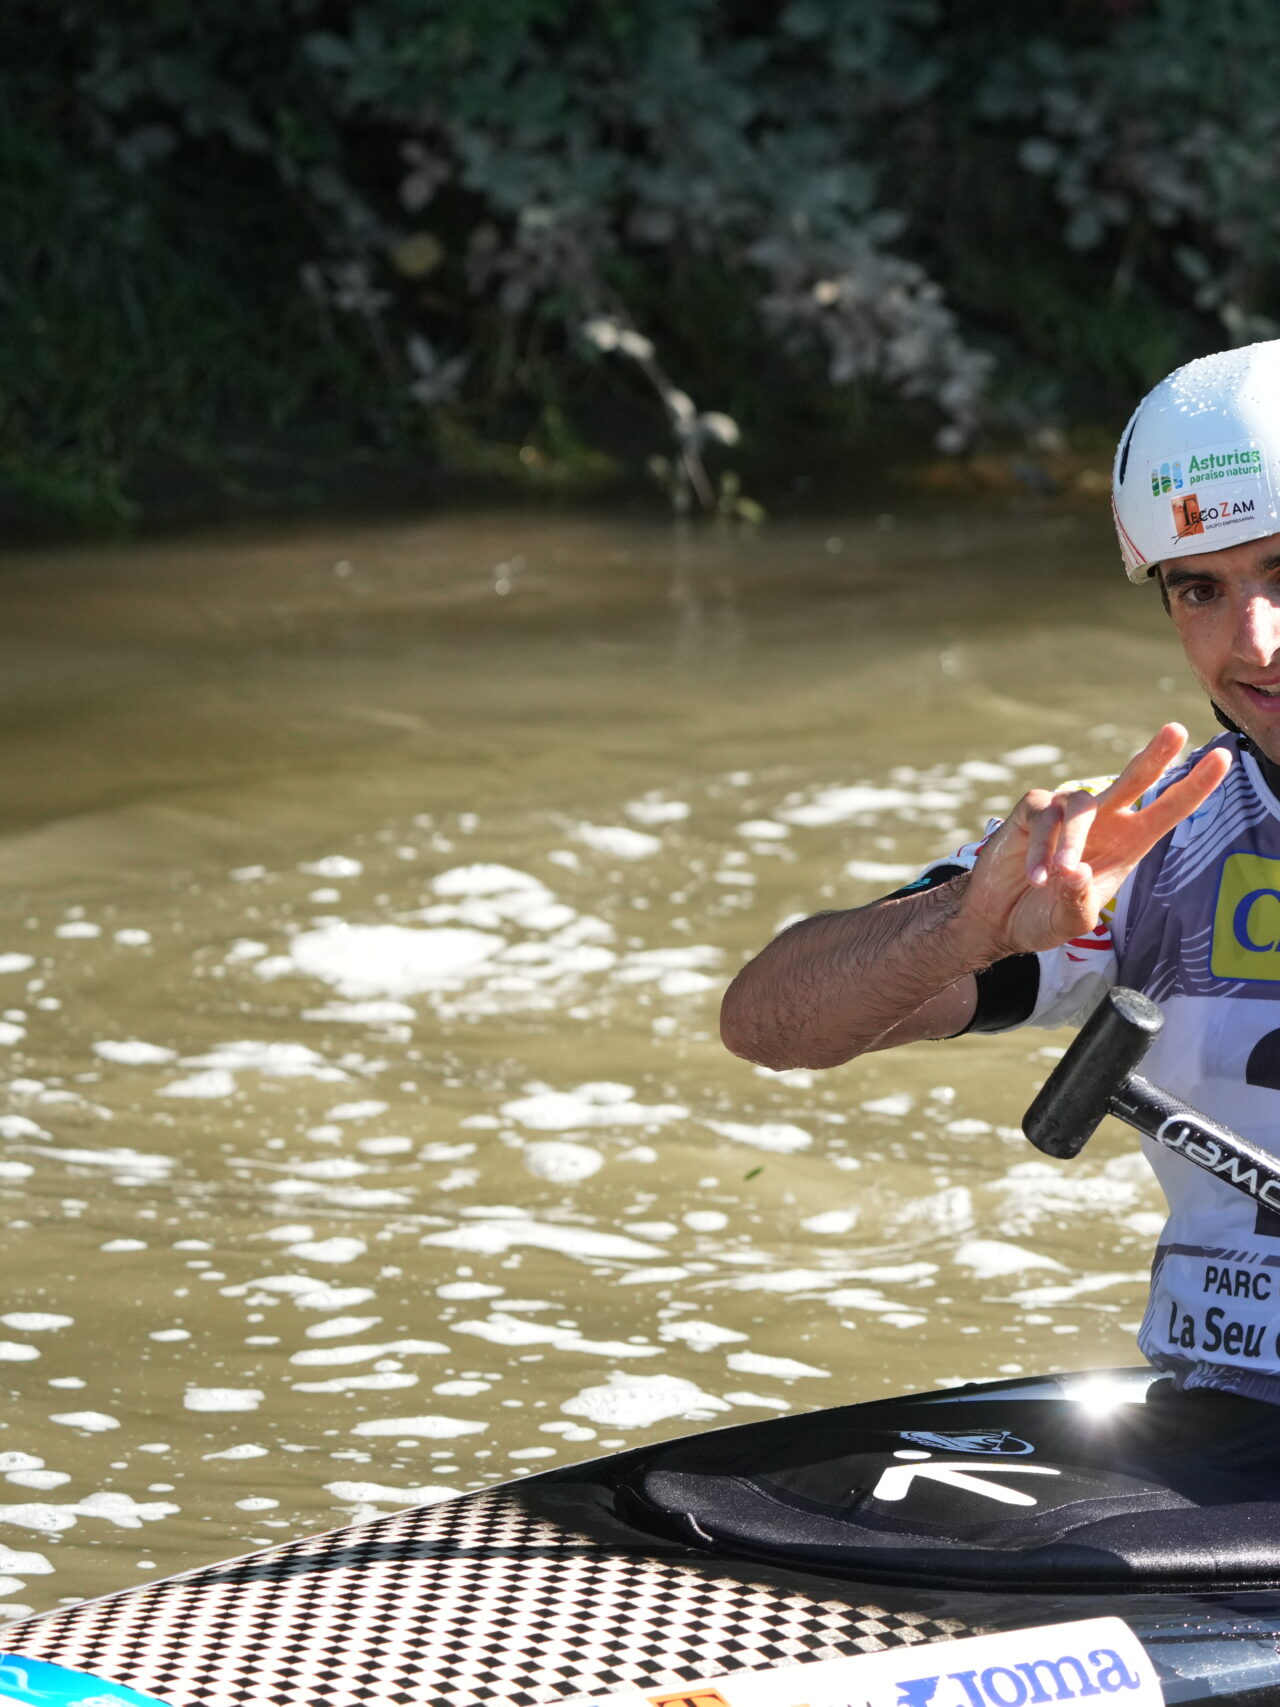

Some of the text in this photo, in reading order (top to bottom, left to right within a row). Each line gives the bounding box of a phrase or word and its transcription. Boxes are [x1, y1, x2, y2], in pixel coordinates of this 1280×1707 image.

[1188, 449, 1260, 473] Asturias
[1226, 464, 1262, 477] natural
[1203, 1265, 1271, 1301] PARC
[1168, 1301, 1196, 1350] La
[1202, 1306, 1267, 1359] Seu
